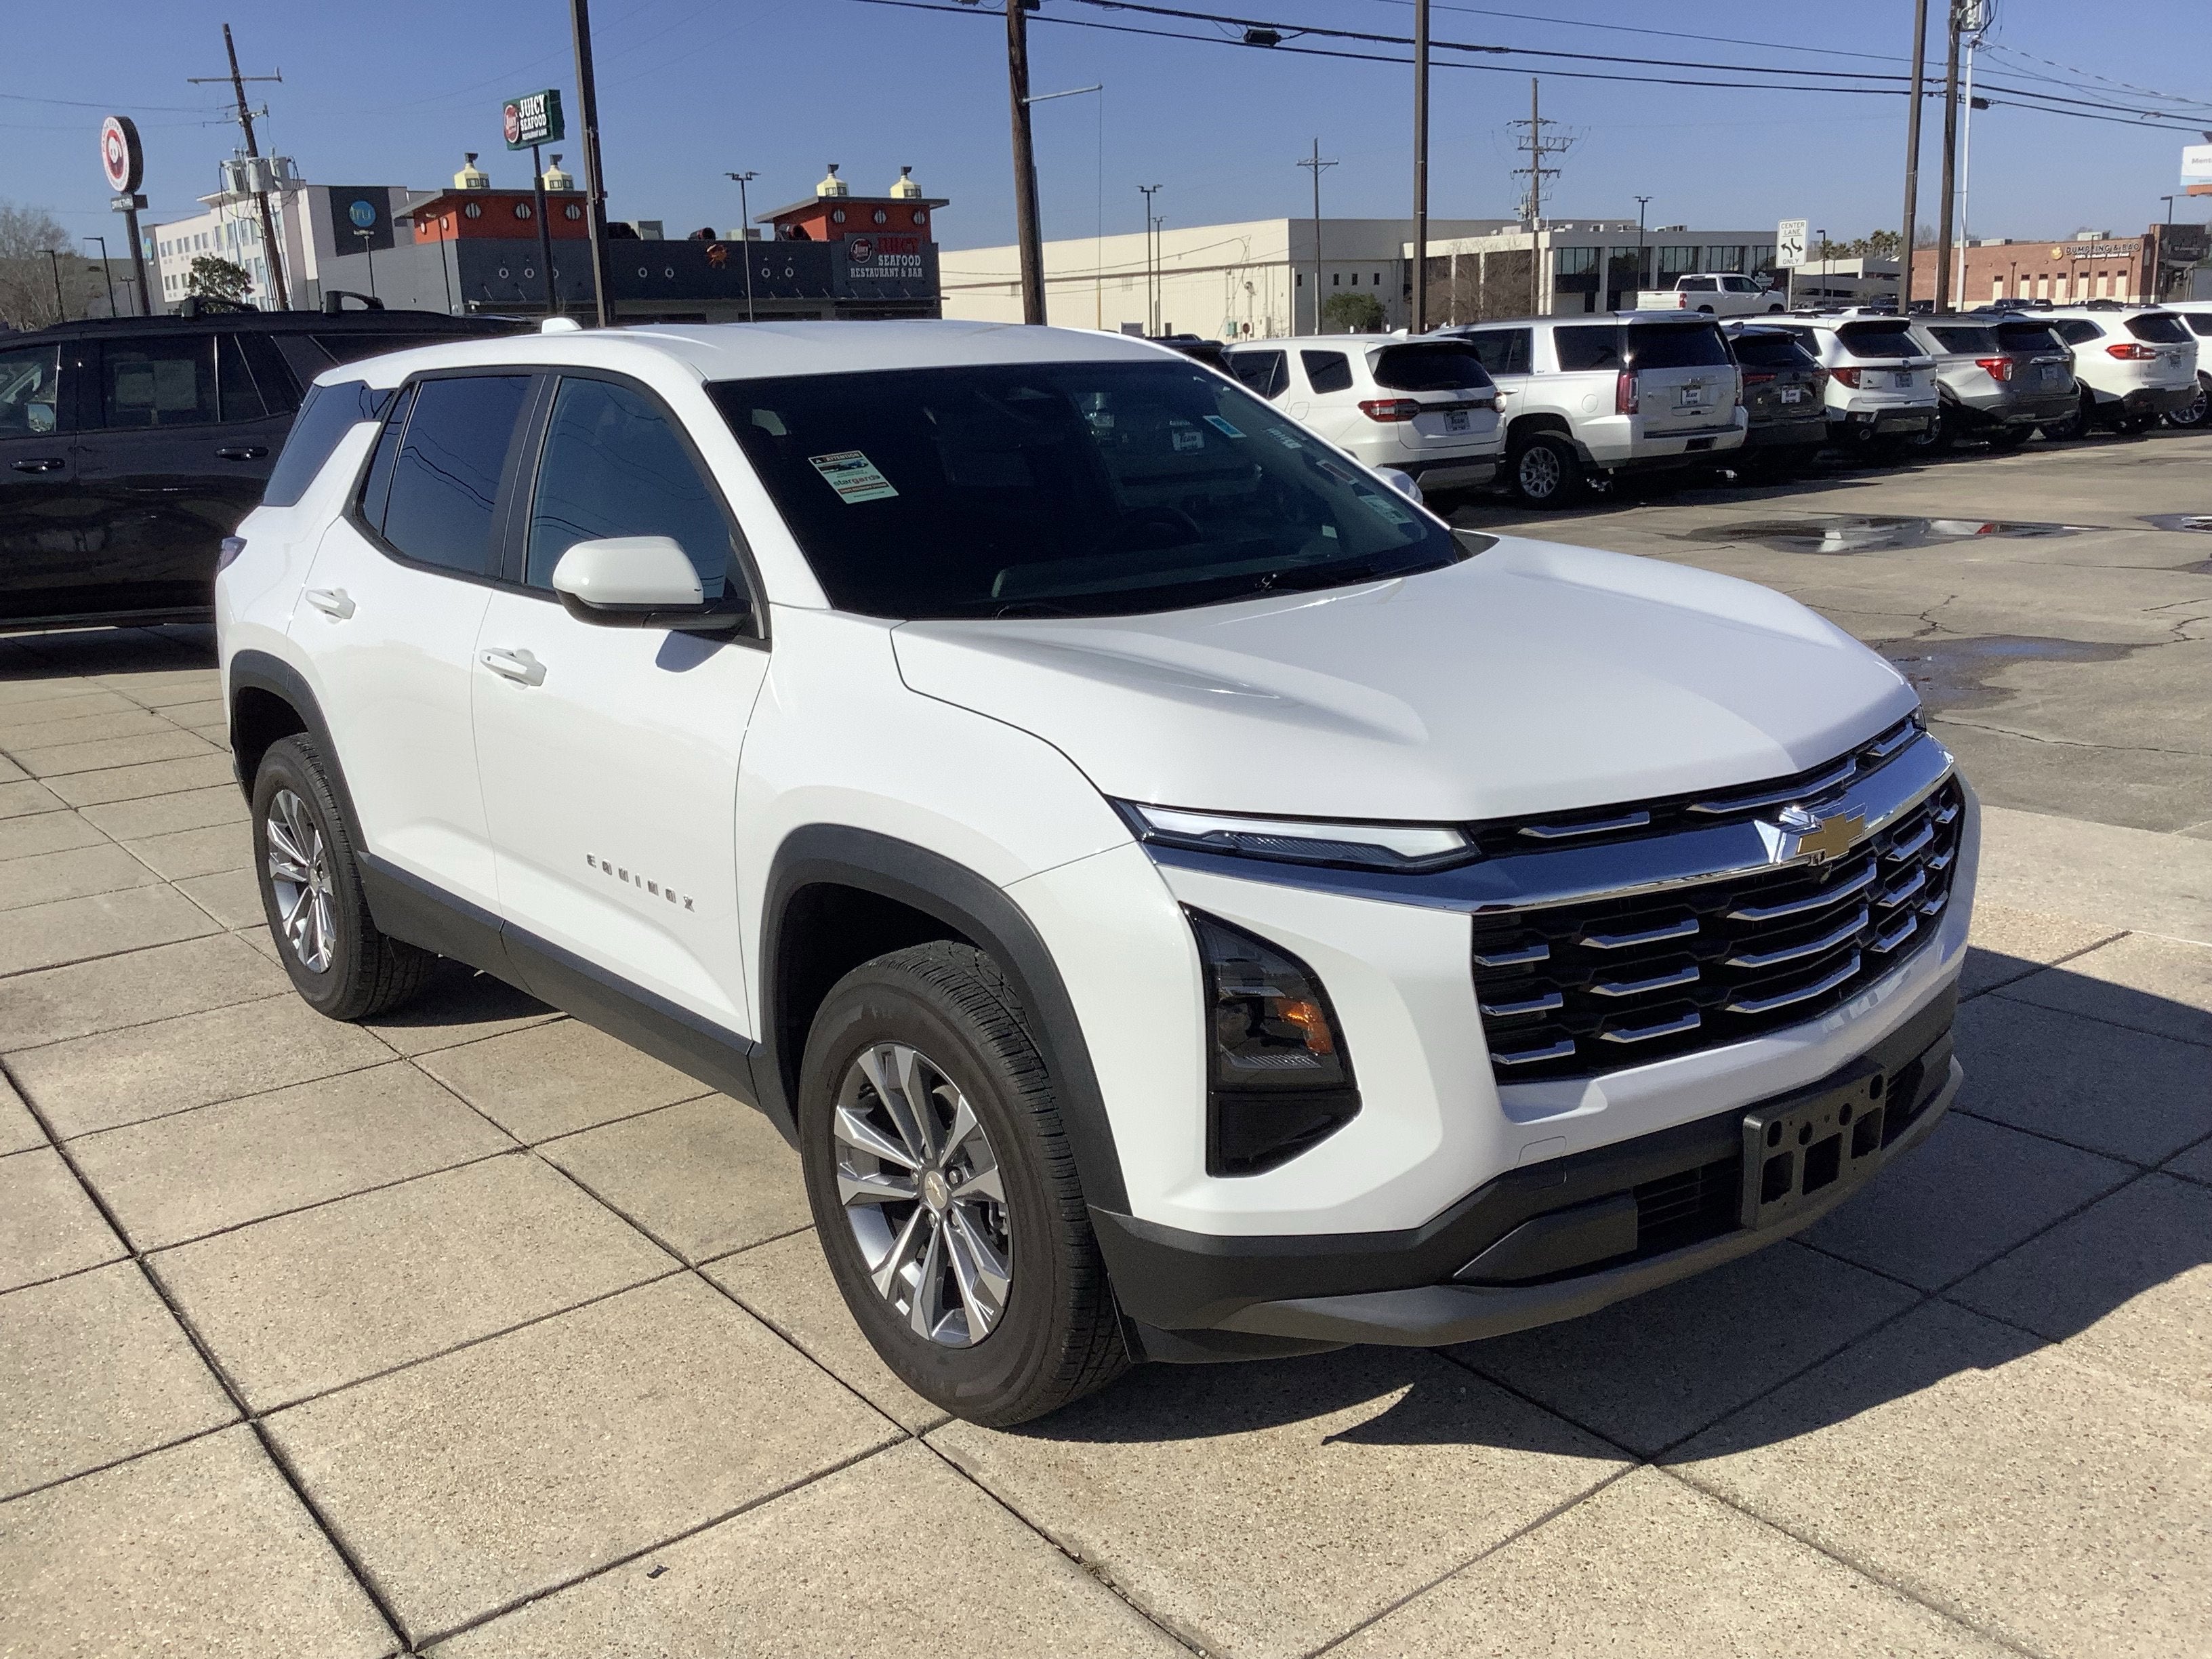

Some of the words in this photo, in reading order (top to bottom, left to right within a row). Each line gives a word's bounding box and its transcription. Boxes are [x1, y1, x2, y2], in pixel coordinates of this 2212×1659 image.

[519, 94, 545, 119] JUICY
[520, 113, 547, 131] SEAFOOD
[1781, 222, 1805, 230] CENTER
[2122, 243, 2141, 252] BAO
[878, 254, 922, 266] SEAFOOD
[850, 267, 899, 279] RESTAURANT
[901, 267, 906, 278] &
[908, 267, 923, 278] BAR
[586, 852, 695, 913] EQUINOX
